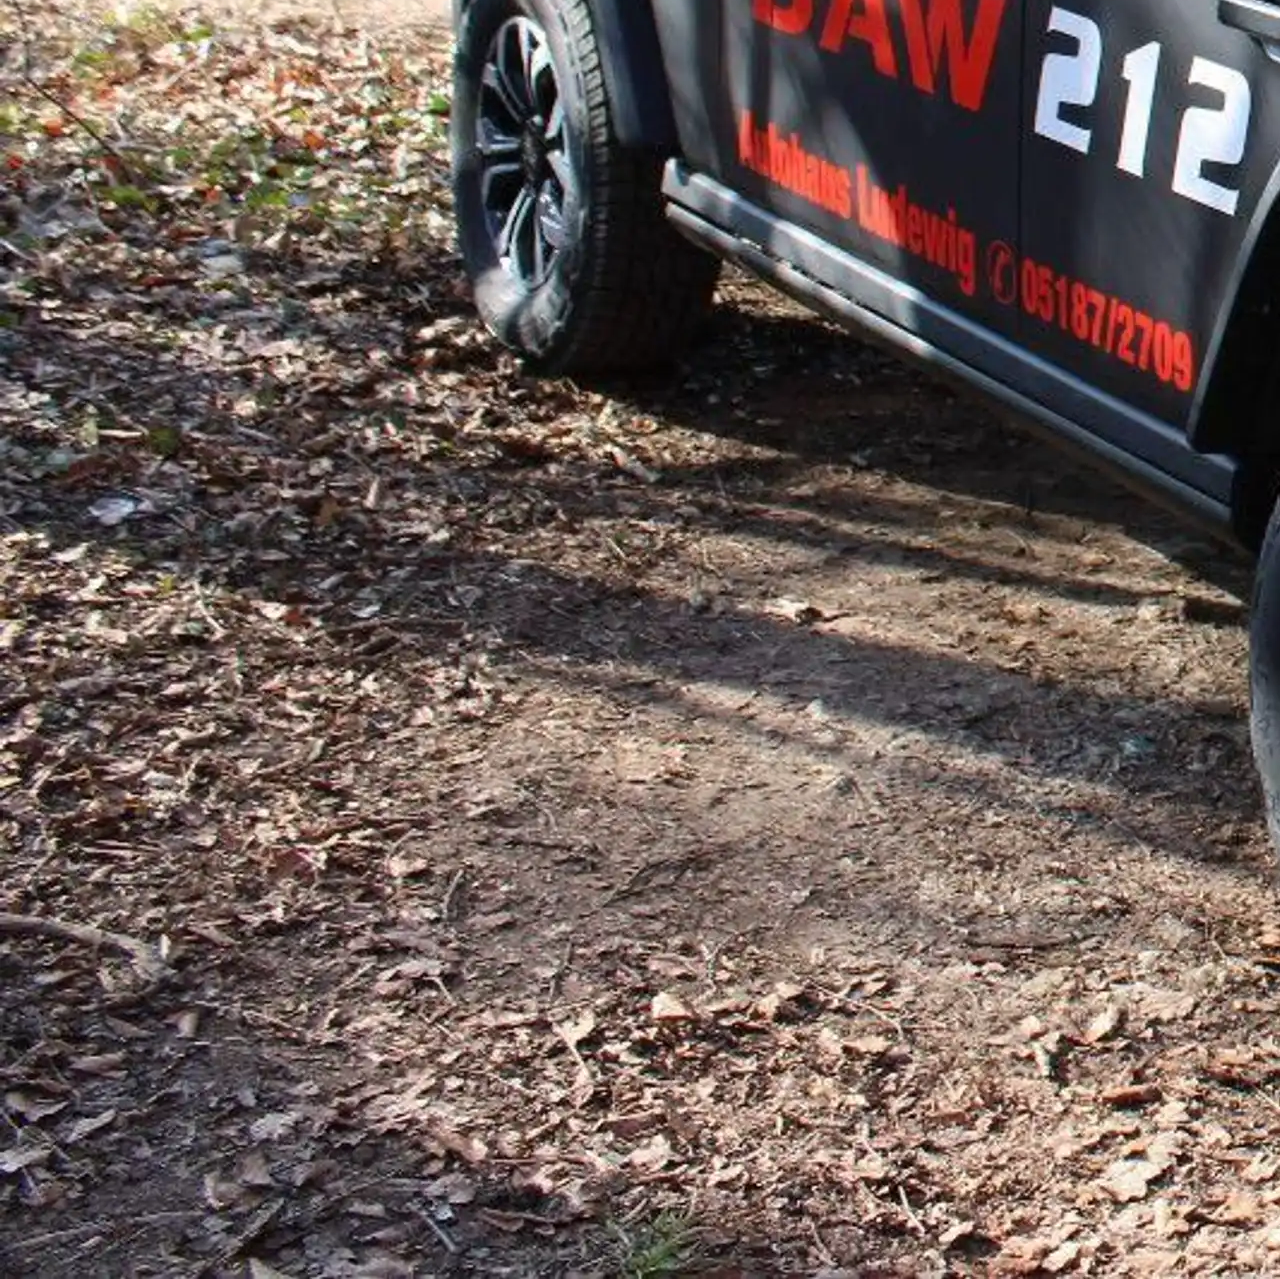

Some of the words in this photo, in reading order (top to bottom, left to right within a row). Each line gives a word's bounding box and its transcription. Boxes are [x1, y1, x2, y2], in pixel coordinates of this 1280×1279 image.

[1034, 5, 1251, 216] 212
[856, 162, 977, 296] Ludewig
[1020, 256, 1195, 392] 05187/2709
